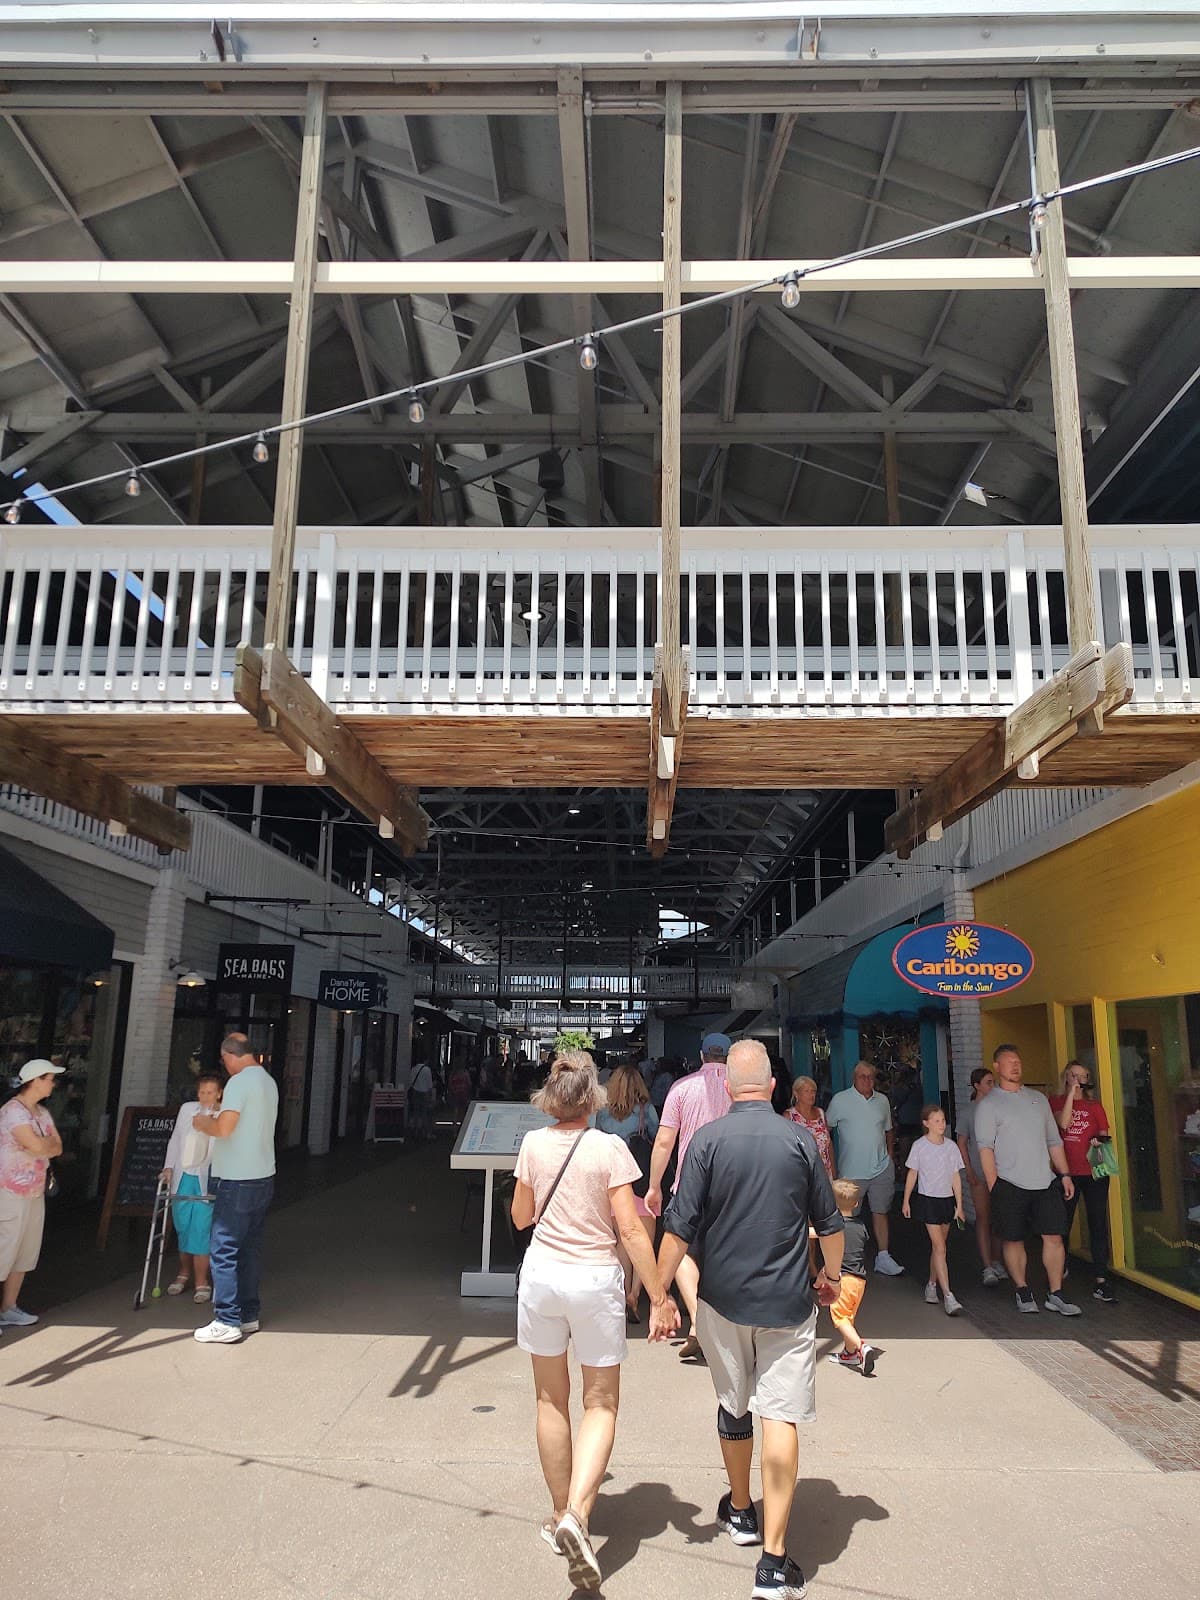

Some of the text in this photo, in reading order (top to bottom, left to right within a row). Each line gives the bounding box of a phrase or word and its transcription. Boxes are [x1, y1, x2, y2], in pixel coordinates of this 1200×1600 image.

[224, 959, 285, 979] SEA BAGS
[907, 958, 1023, 980] Caribongo
[937, 981, 993, 992] Fun in the Sun!
[324, 987, 370, 1001] HOME
[138, 1119, 175, 1131] SEA BAGS
